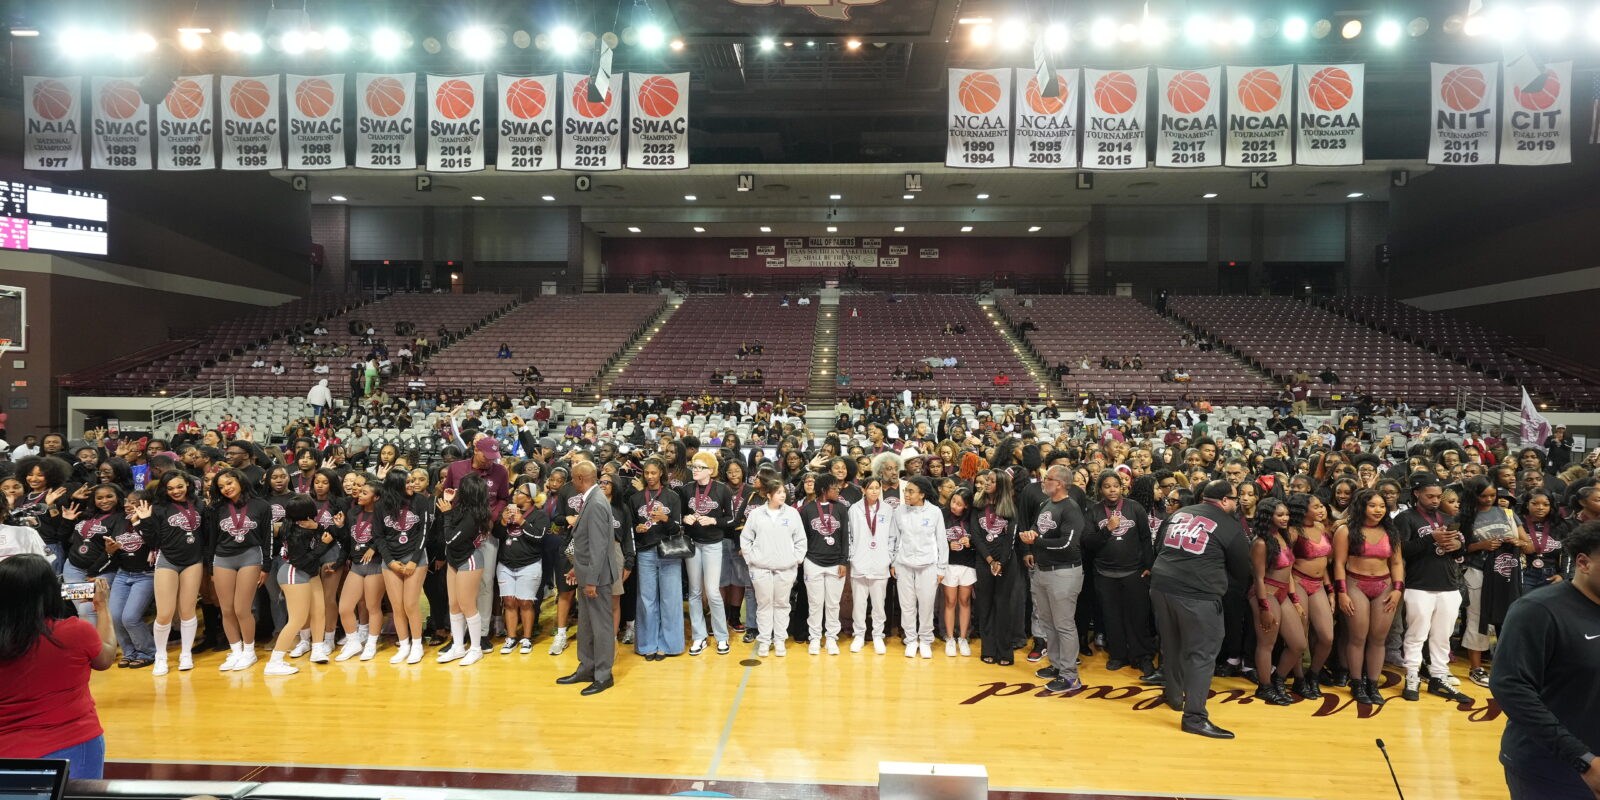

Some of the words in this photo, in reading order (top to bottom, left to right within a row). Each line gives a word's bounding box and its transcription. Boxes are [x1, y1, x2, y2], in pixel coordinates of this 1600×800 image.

[954, 115, 1005, 129] NCAA
[1020, 115, 1072, 129] NCAA
[1091, 117, 1140, 131] NCAA
[1161, 114, 1218, 131] NCAA
[1230, 113, 1288, 130] NCAA
[1300, 112, 1360, 129] NCAA
[1437, 109, 1491, 129] NIT
[1511, 109, 1561, 129] CIT
[28, 118, 78, 134] NAIA
[95, 119, 147, 136] SWAC
[160, 119, 212, 135] SWAC
[224, 119, 277, 135] SWAC
[291, 118, 341, 134] SWAC
[360, 117, 412, 134] SWAC
[431, 119, 481, 136] SWAC
[501, 119, 552, 136] SWAC
[565, 119, 618, 136] SWAC
[632, 118, 686, 134] SWAC
[949, 129, 1008, 138] TOURNAMENT
[1017, 129, 1075, 138] TOURNAMENT
[1086, 131, 1144, 139] TOURNAMENT
[1164, 130, 1213, 139] TOURNAMENT
[1234, 129, 1284, 138] TOURNAMENT
[1303, 128, 1355, 137] TOURNAMENT
[301, 144, 331, 153] 1998
[371, 144, 400, 153] 2011
[643, 144, 675, 153] 2022
[963, 141, 995, 151] 1990
[1030, 141, 1062, 151] 1995
[1098, 142, 1132, 152] 2014
[1173, 141, 1205, 151] 2017
[1242, 141, 1276, 151] 2021
[1311, 139, 1346, 149] 2023
[1444, 140, 1479, 150] 2011
[1517, 140, 1555, 151] 2019
[107, 145, 137, 155] 1983
[172, 145, 201, 154] 1990
[237, 145, 267, 154] 1994
[440, 146, 471, 156] 2014
[511, 146, 542, 155] 2016
[575, 145, 607, 154] 2018
[106, 156, 137, 166] 1988
[172, 156, 201, 166] 1992
[237, 156, 267, 166] 1995
[302, 156, 331, 165] 2003
[371, 156, 401, 165] 2013
[512, 157, 542, 167] 2017
[575, 156, 607, 166] 2021
[642, 156, 675, 165] 2023
[962, 153, 994, 163] 1994
[1029, 153, 1062, 162] 2003
[1098, 155, 1131, 165] 2015
[1171, 152, 1205, 163] 2018
[1241, 152, 1277, 162] 2022
[1443, 152, 1479, 162] 2016
[38, 158, 68, 168] 1977
[440, 158, 471, 168] 2015
[294, 178, 305, 190] Q
[418, 177, 430, 189] P
[577, 177, 589, 189] O
[740, 176, 753, 190] N
[906, 175, 920, 188] M
[1078, 175, 1090, 188] L
[1252, 173, 1265, 187] K
[1394, 172, 1406, 186] J
[1164, 512, 1218, 556] 26
[1170, 522, 1203, 540] Fall
[960, 671, 1402, 718] Mrland
